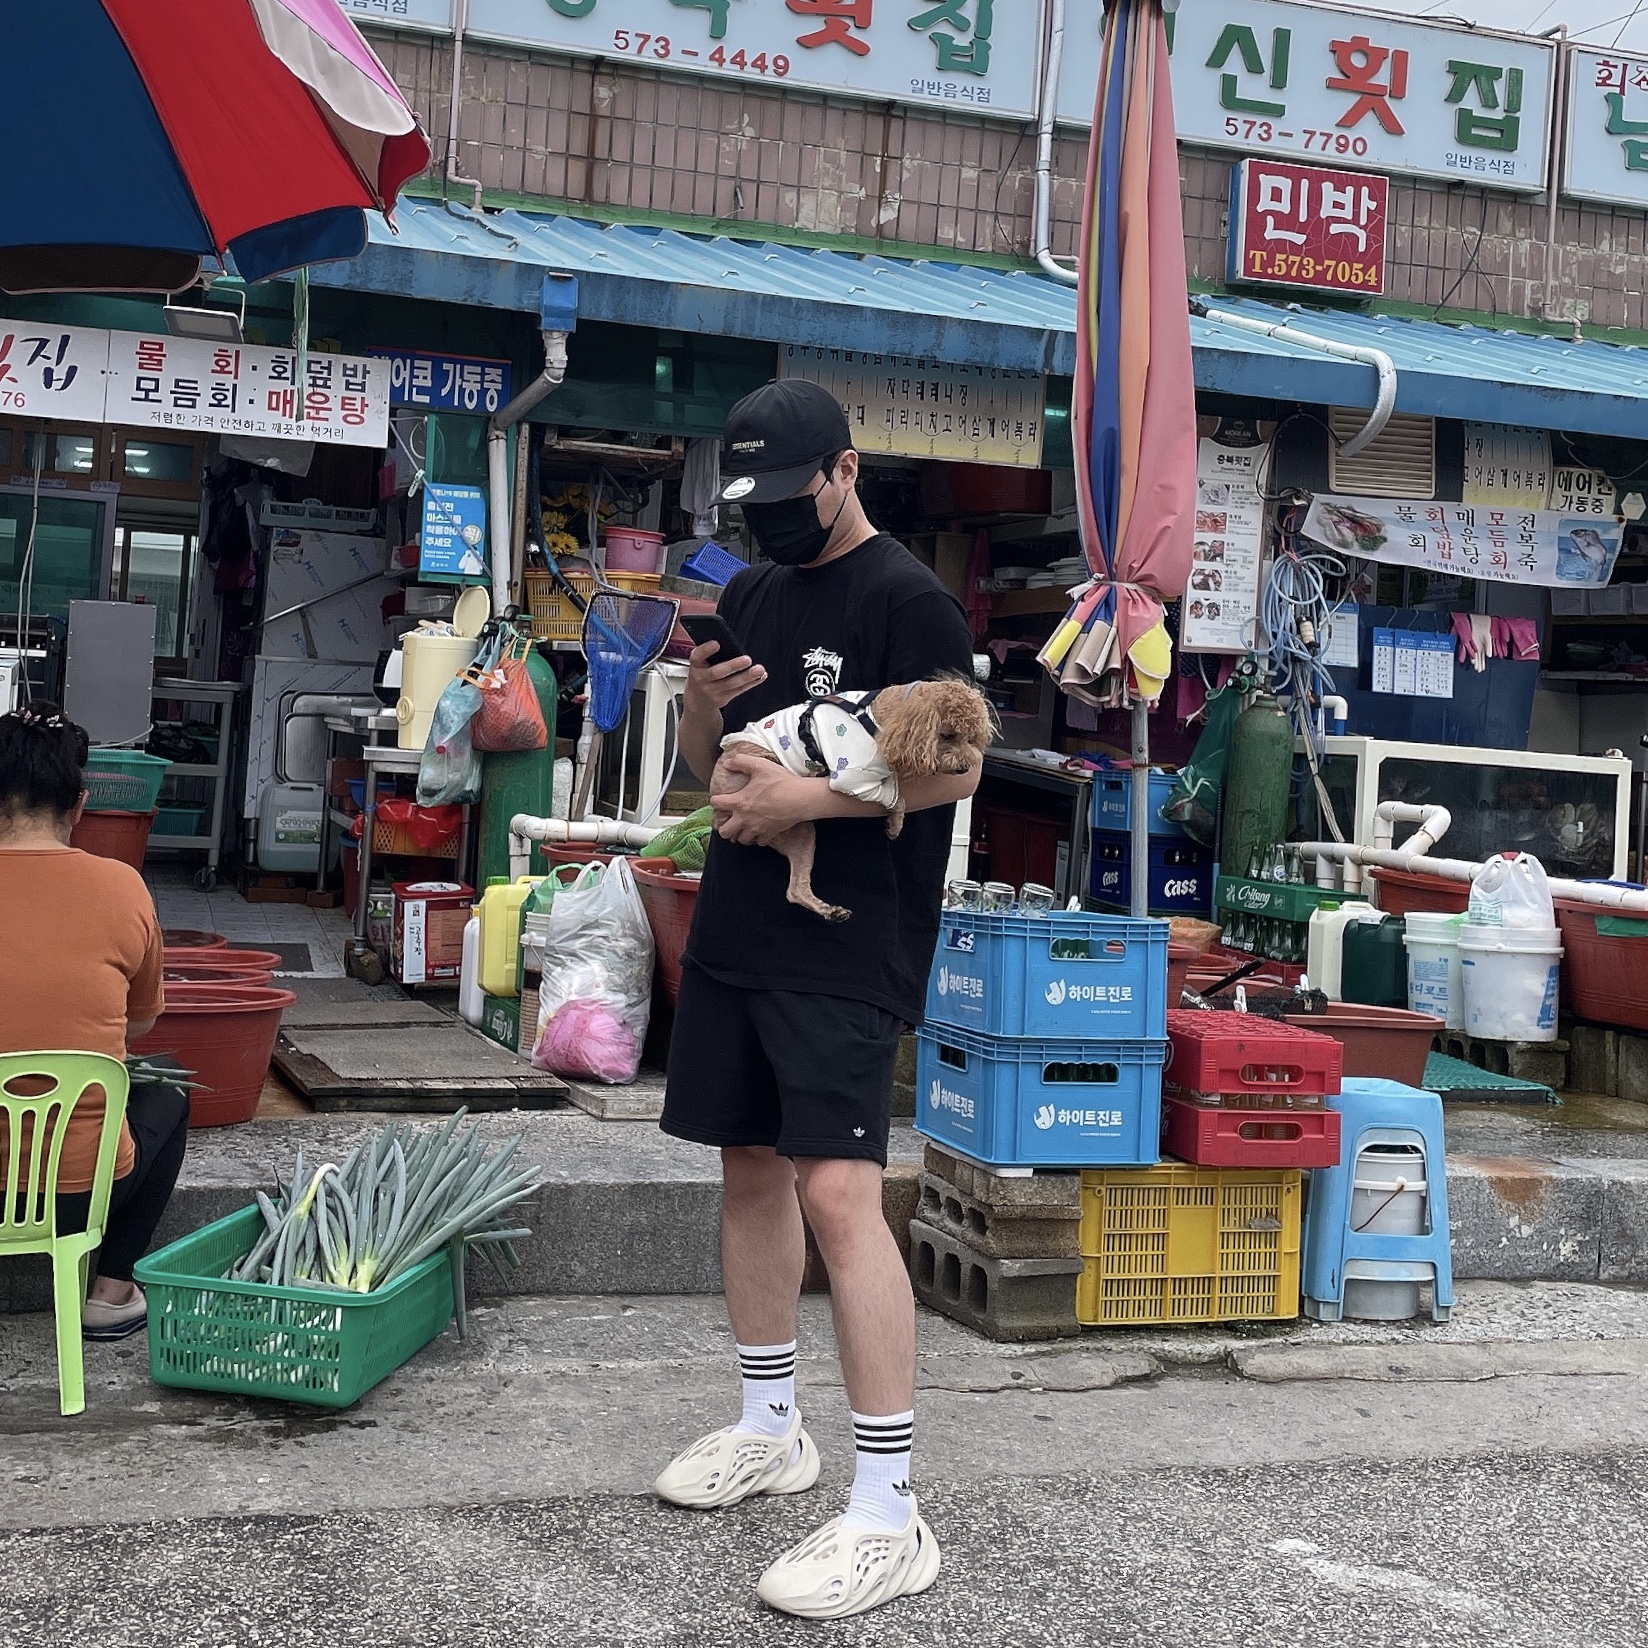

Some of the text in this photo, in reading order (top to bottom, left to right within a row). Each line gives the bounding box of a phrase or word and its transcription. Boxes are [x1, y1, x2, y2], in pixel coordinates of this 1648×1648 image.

[613, 29, 790, 77] 573-4449
[910, 79, 991, 103] 일반음식점
[1225, 117, 1368, 156] 573-7790
[1445, 152, 1515, 175] 일반음식점
[1257, 174, 1377, 252] 민박
[441, 363, 502, 412] 가동중
[150, 411, 186, 425] 저렴한
[191, 414, 214, 429] 가격
[219, 417, 266, 432] 안전하고
[271, 422, 305, 437] 깨끗한
[1560, 494, 1604, 514] 가동중
[949, 973, 984, 998] 하이트진로
[1069, 985, 1132, 1002] 하이트진로
[941, 1088, 975, 1119] 하이트진로
[1058, 1110, 1122, 1127] 하이트진로
